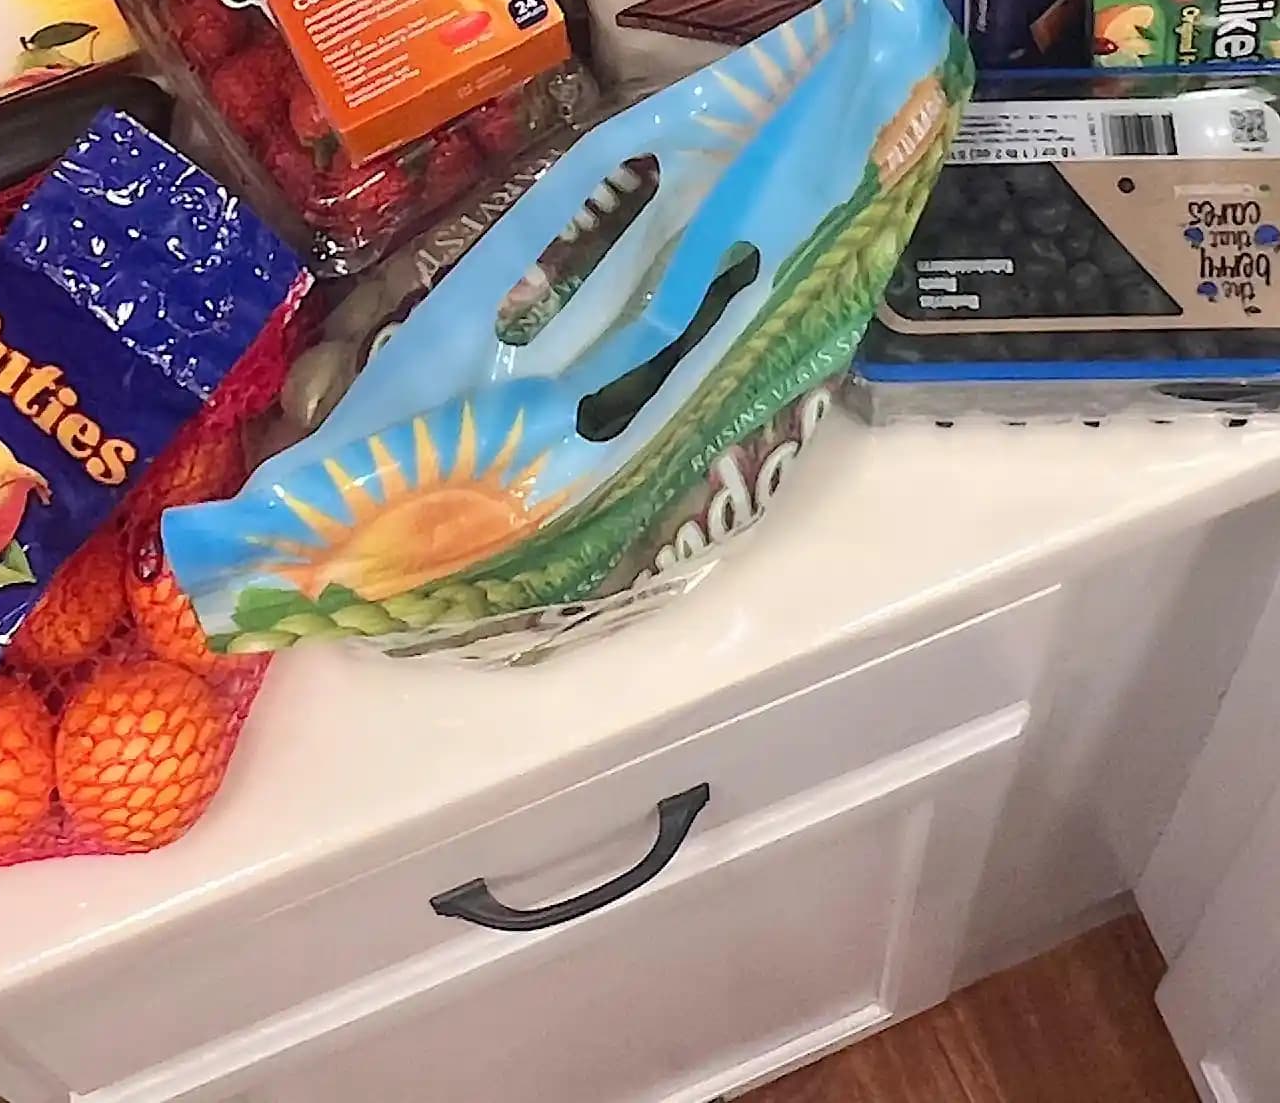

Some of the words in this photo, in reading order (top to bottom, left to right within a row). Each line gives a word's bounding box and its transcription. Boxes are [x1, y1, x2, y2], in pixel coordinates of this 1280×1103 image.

[1188, 201, 1262, 228] cares
[1208, 230, 1252, 251] that
[1200, 247, 1271, 287] berry
[1222, 281, 1256, 305] the
[689, 399, 768, 472] RAISINS
